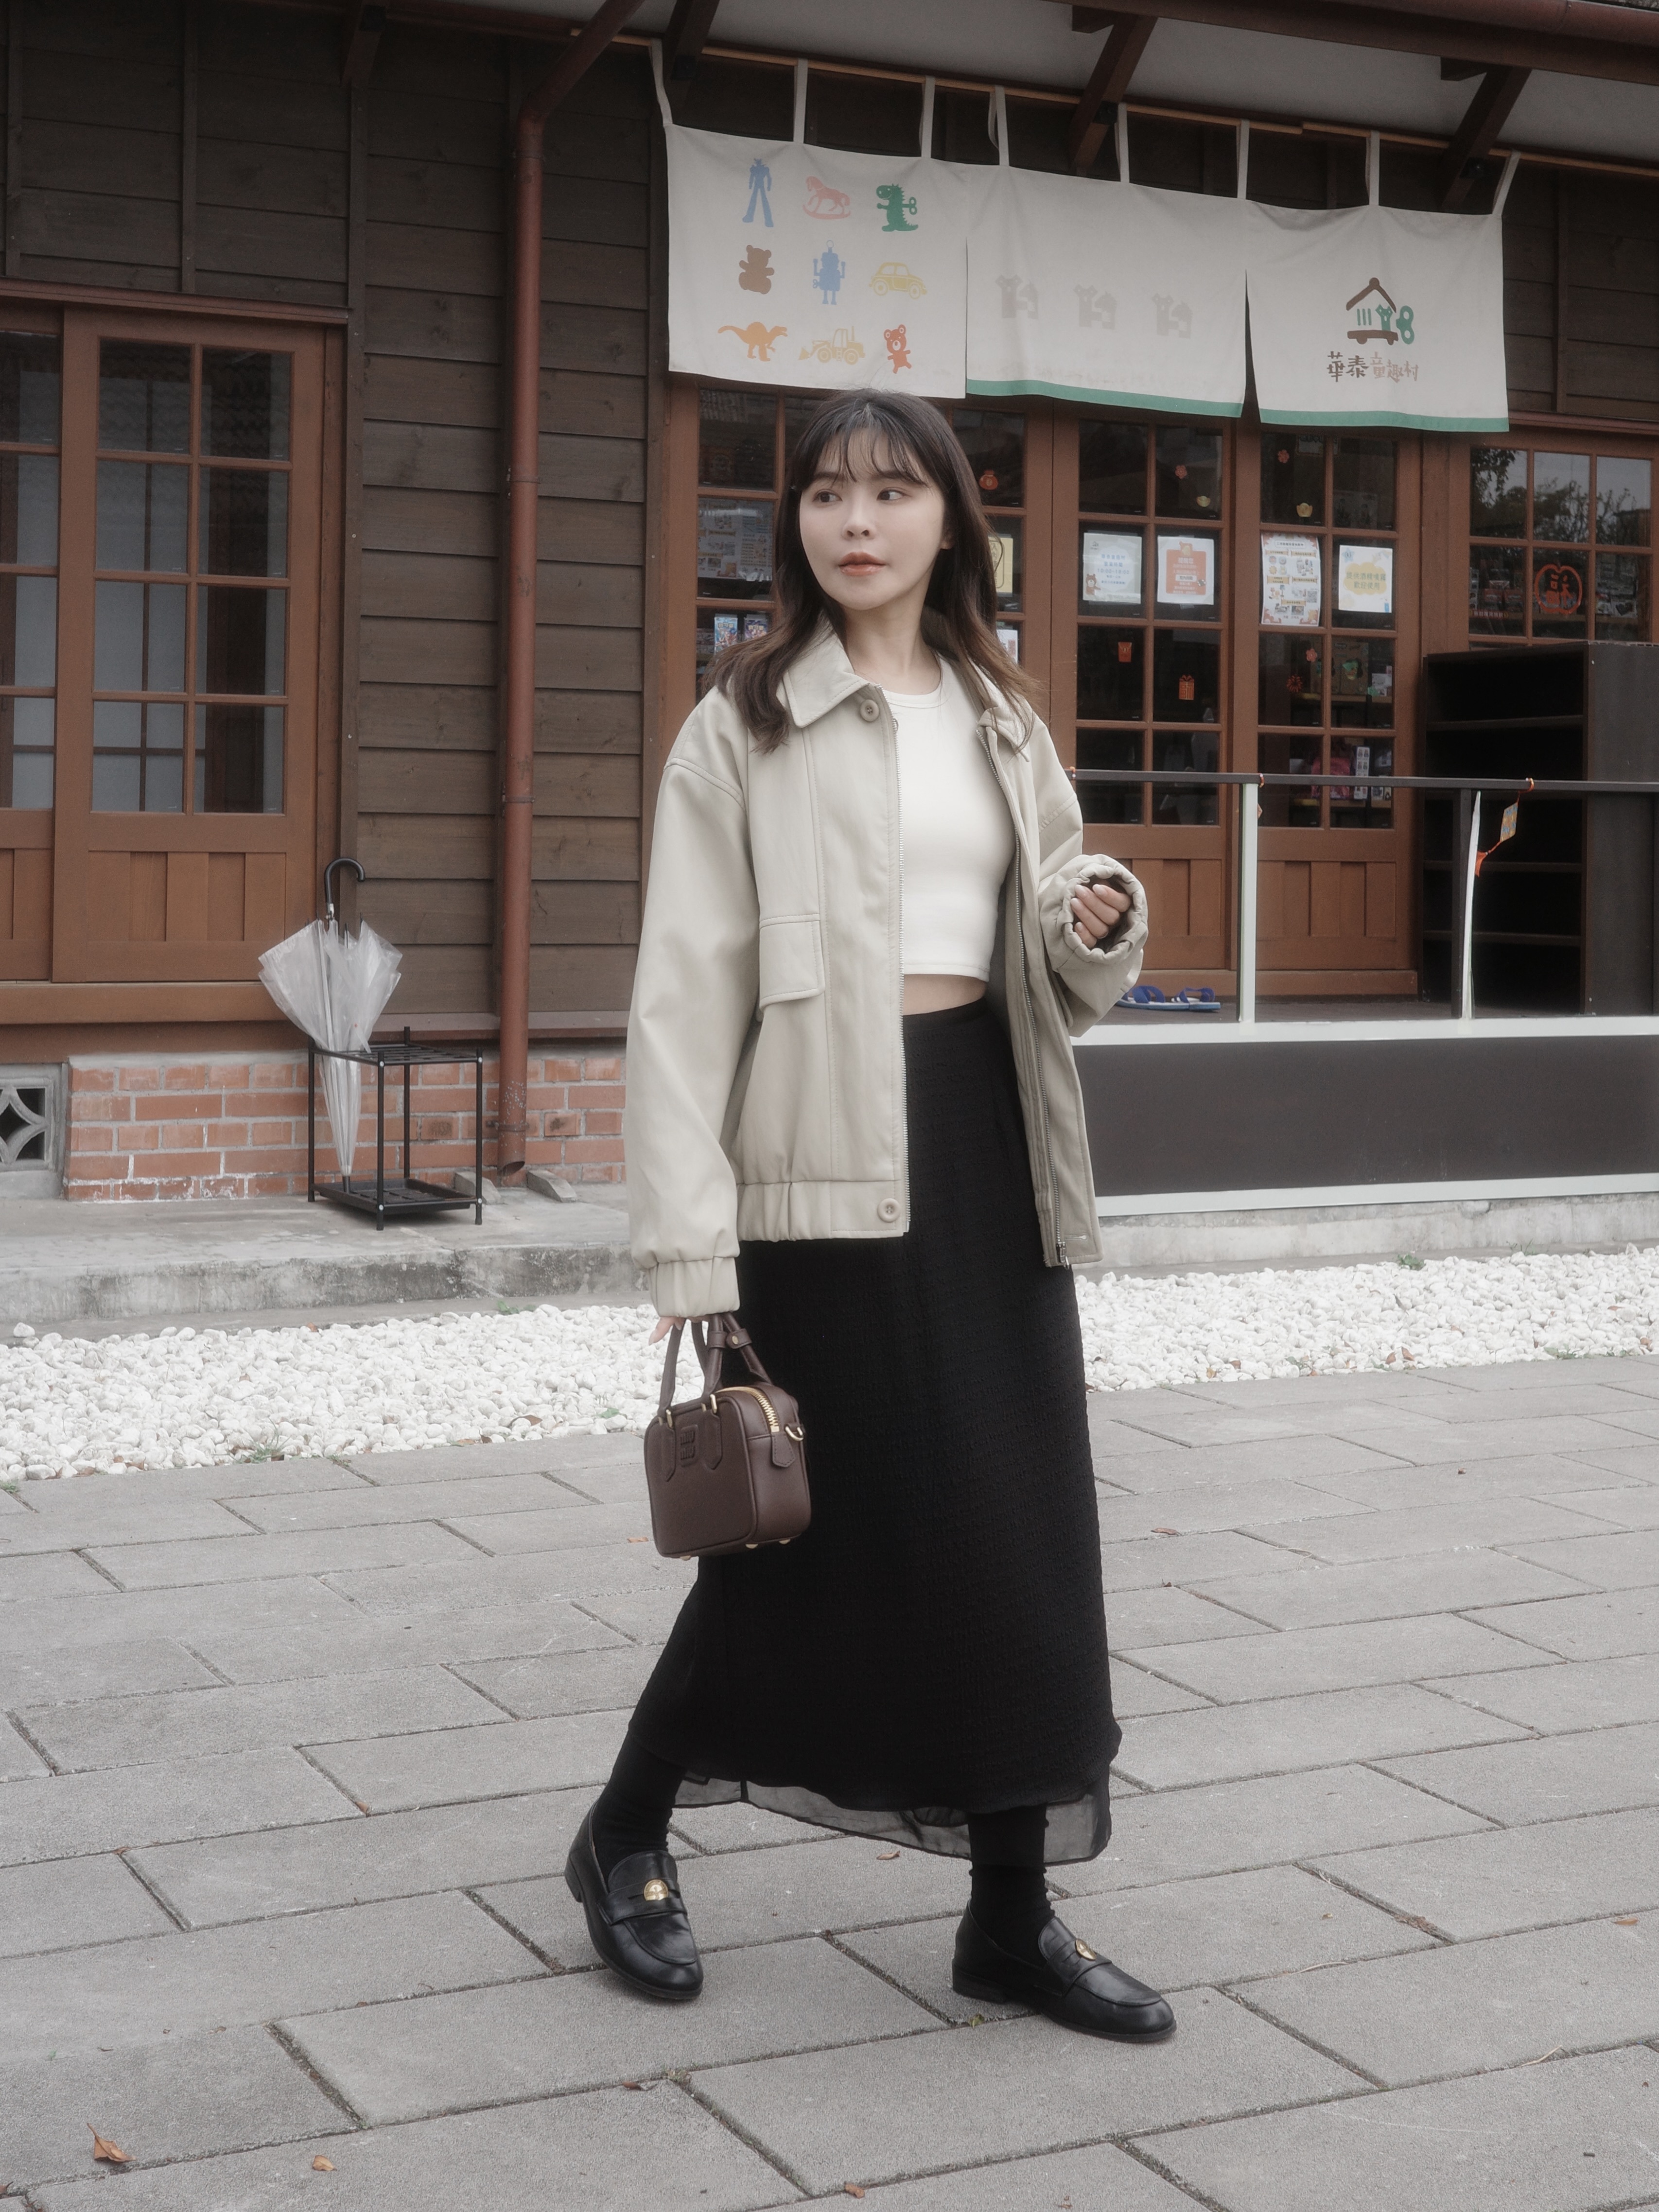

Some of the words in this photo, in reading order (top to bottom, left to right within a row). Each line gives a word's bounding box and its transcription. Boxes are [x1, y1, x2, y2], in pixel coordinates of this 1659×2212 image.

[1327, 351, 1419, 383] 華泰童趣村
[1354, 581, 1380, 590] 歡迎使用
